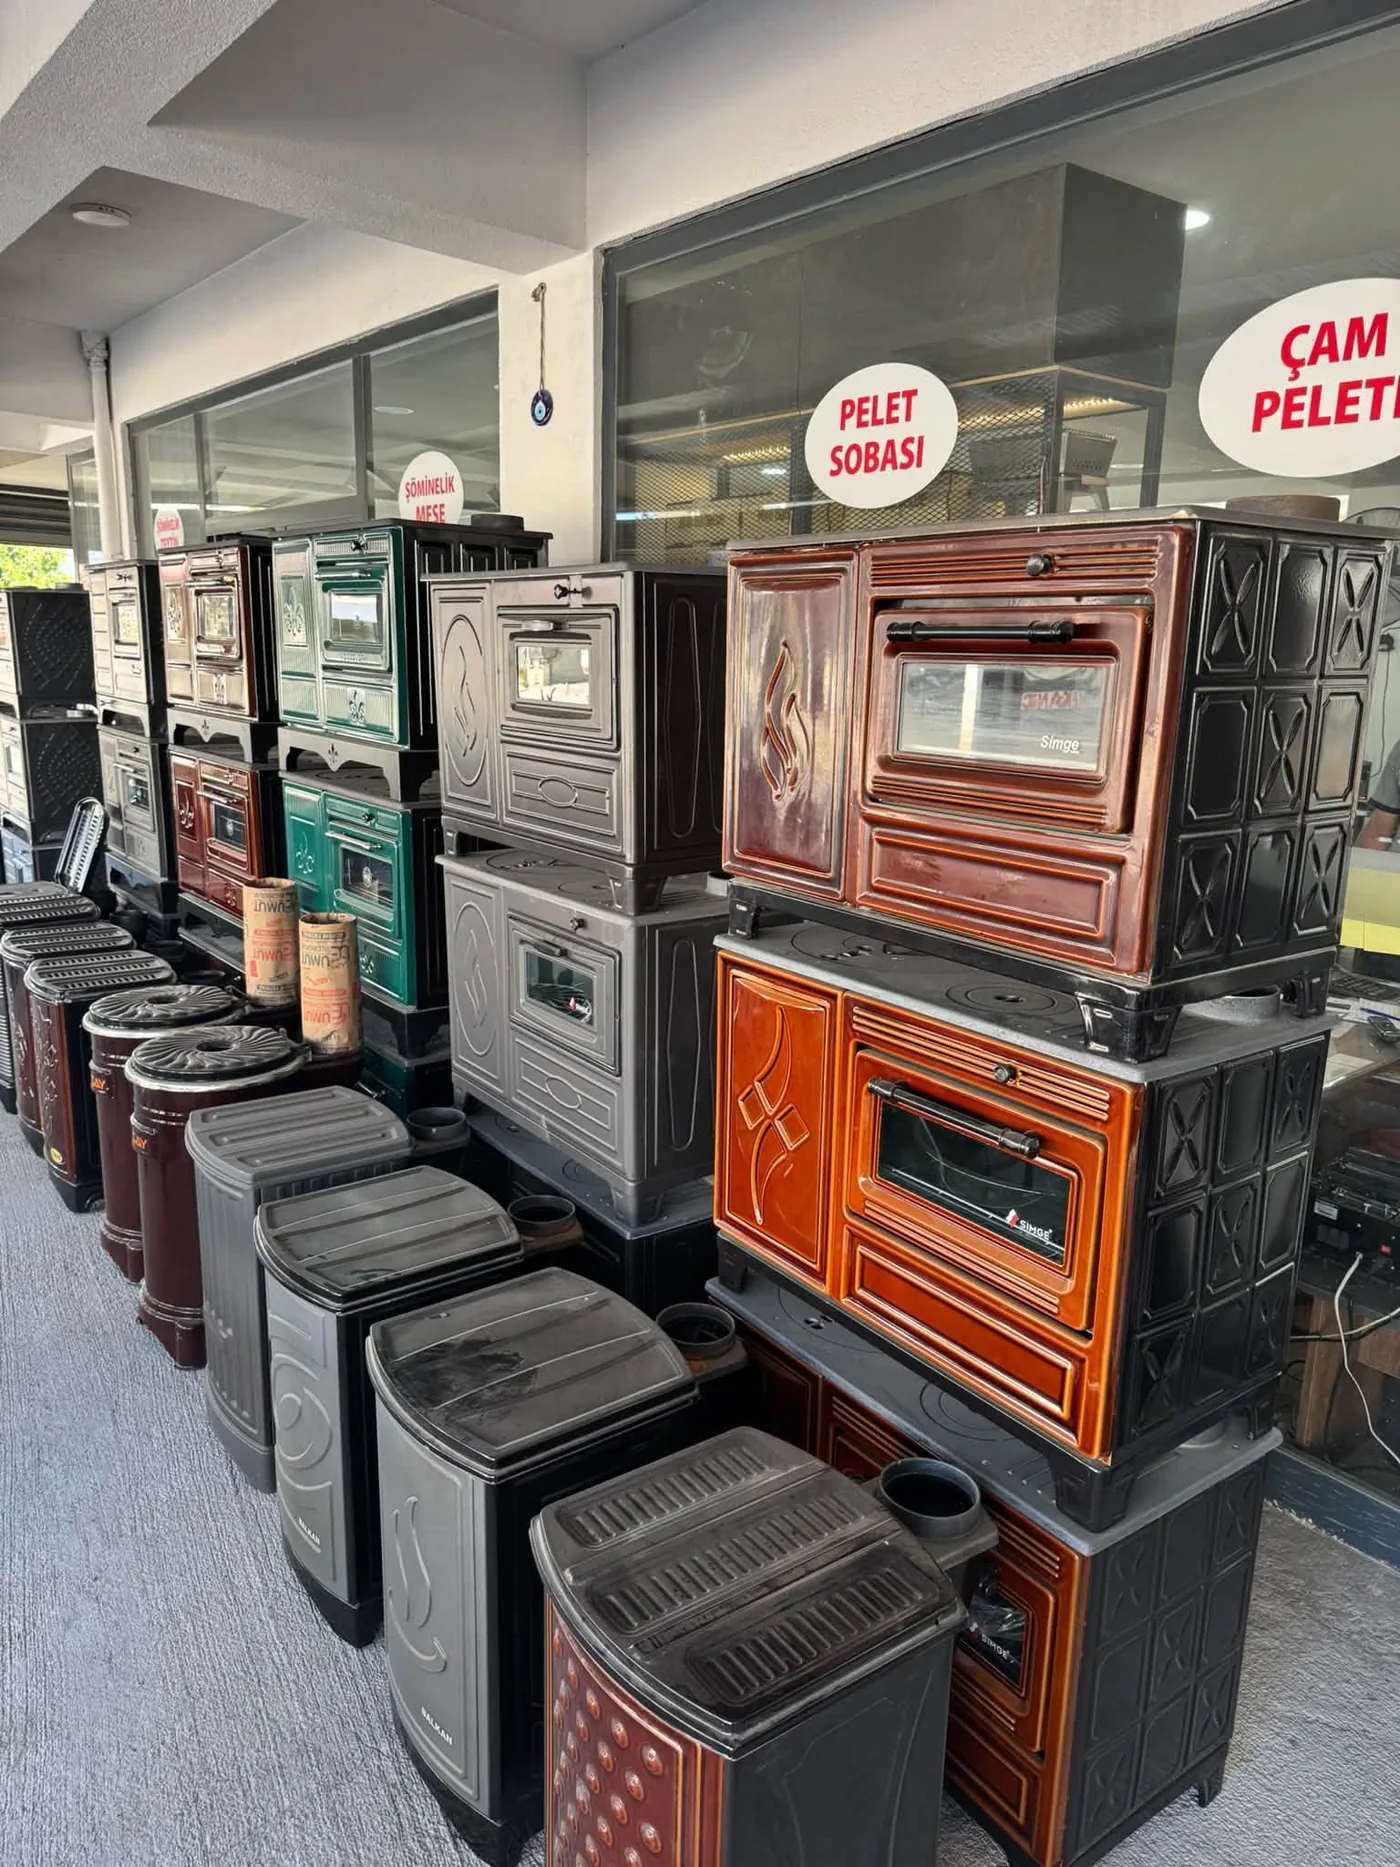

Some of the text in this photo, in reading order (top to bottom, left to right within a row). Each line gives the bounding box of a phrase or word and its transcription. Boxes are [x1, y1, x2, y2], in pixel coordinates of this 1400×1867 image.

[1280, 312, 1389, 382] ÇAM
[839, 388, 919, 431] PELET
[829, 435, 925, 478] SOBASI
[405, 472, 455, 504] ŞÖMİNELİK
[1040, 735, 1080, 755] Simge
[421, 1705, 453, 1746] BALKAN
